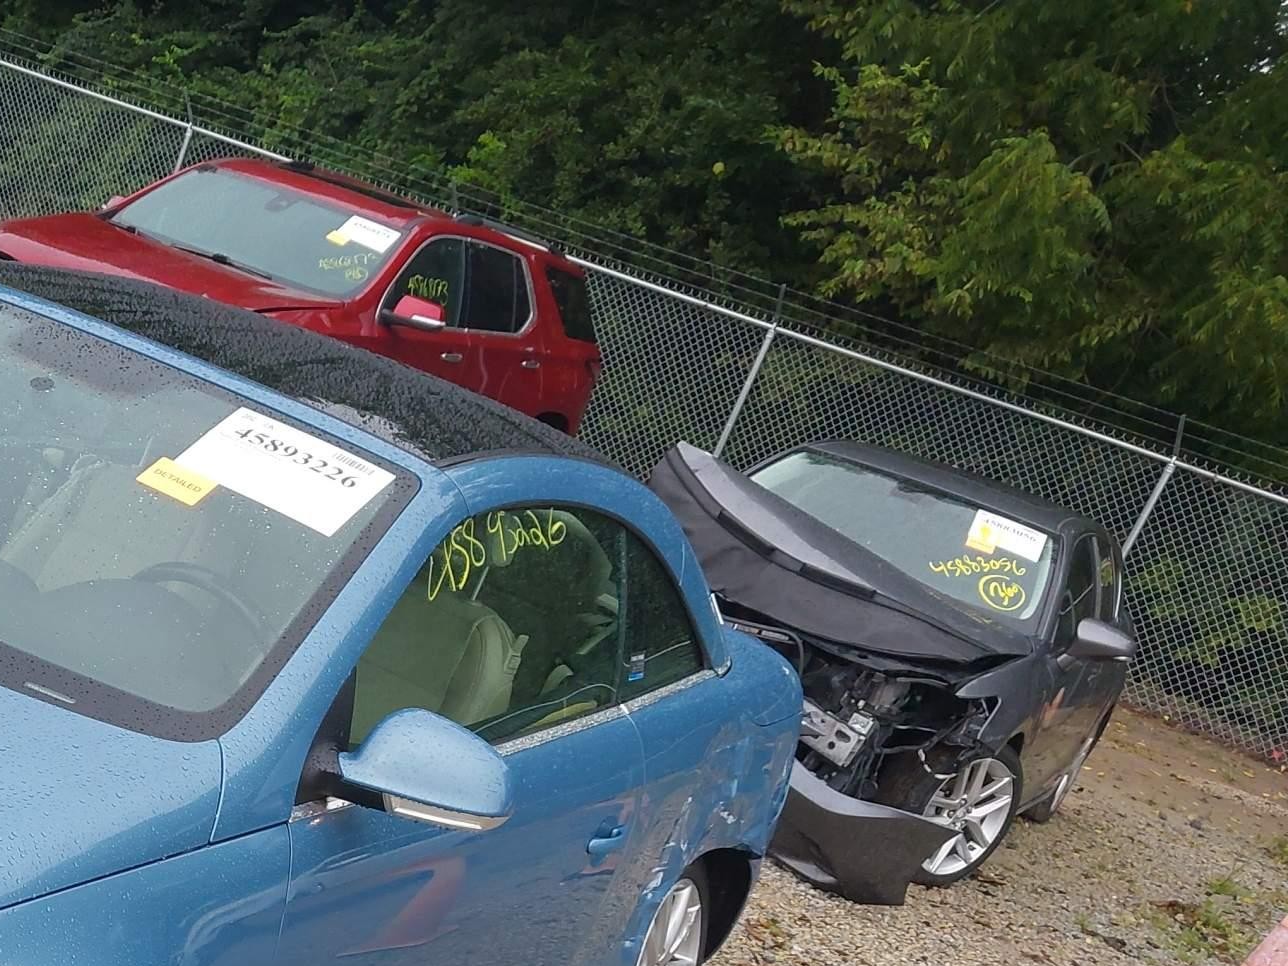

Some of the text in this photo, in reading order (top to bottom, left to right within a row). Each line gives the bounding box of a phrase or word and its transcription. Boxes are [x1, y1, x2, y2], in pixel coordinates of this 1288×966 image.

[234, 428, 360, 488] 45893226
[153, 468, 202, 493] DETAILED
[928, 554, 1027, 578] 45883056
